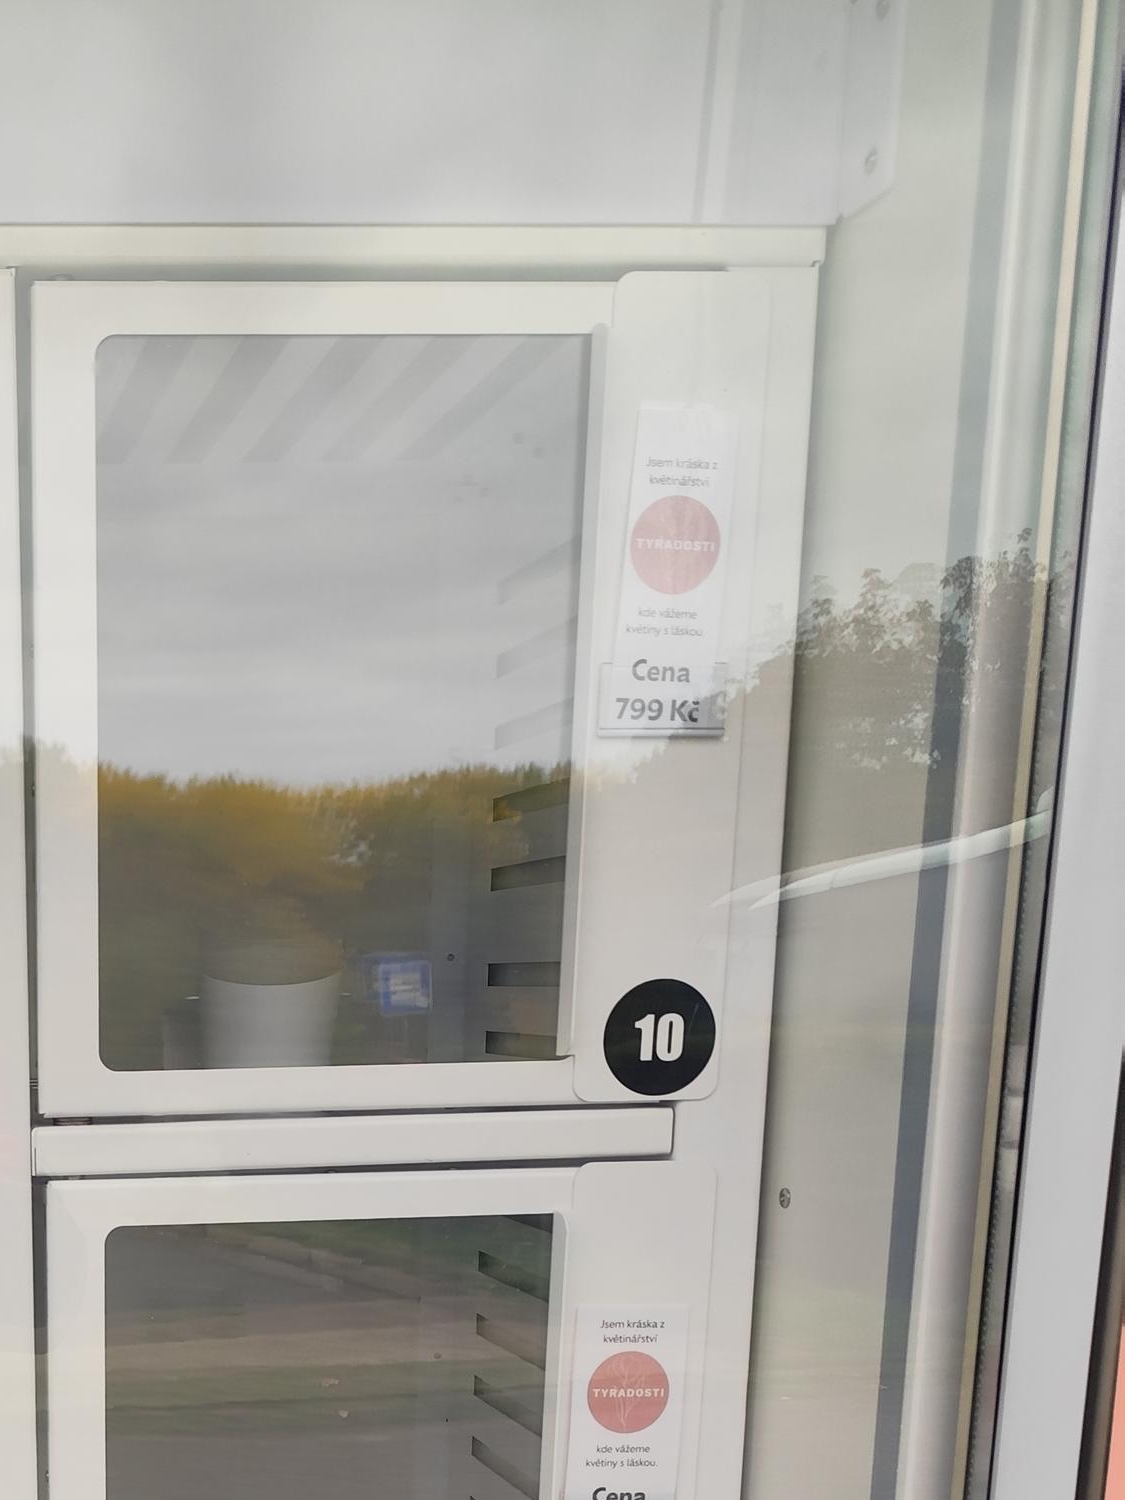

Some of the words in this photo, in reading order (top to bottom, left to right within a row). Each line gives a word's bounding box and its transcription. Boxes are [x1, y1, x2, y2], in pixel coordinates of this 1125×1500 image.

[635, 538, 715, 552] TYRADOSTI
[631, 658, 690, 683] Cena
[615, 697, 664, 721] 799
[670, 699, 700, 723] Kč
[635, 1013, 685, 1062] 10
[600, 1320, 625, 1329] Jsem
[626, 1320, 658, 1329] kráska
[603, 1334, 658, 1344] květinářství
[593, 1388, 665, 1398] TYRADOSTI
[596, 1444, 613, 1453] kde
[615, 1444, 651, 1453] vážeme
[585, 1459, 618, 1469] květiny
